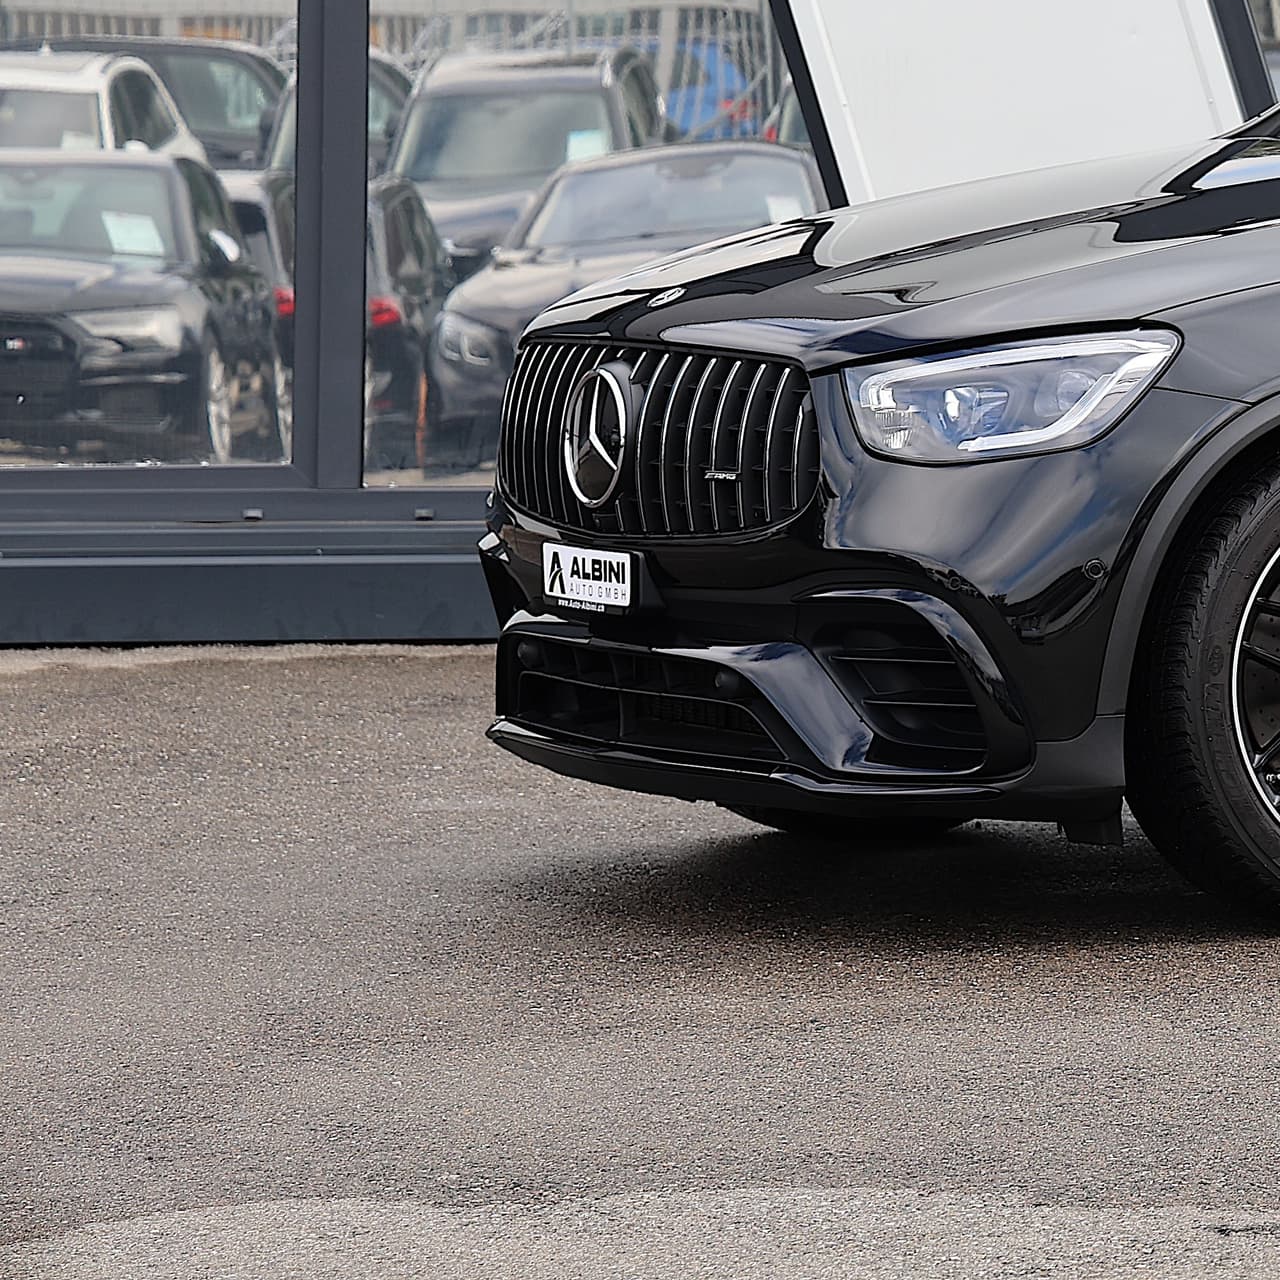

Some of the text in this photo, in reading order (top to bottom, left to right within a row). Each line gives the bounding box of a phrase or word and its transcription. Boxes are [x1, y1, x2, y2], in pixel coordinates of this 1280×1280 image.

[570, 556, 626, 585] ALBINI
[570, 582, 627, 600] AUTO GMBH
